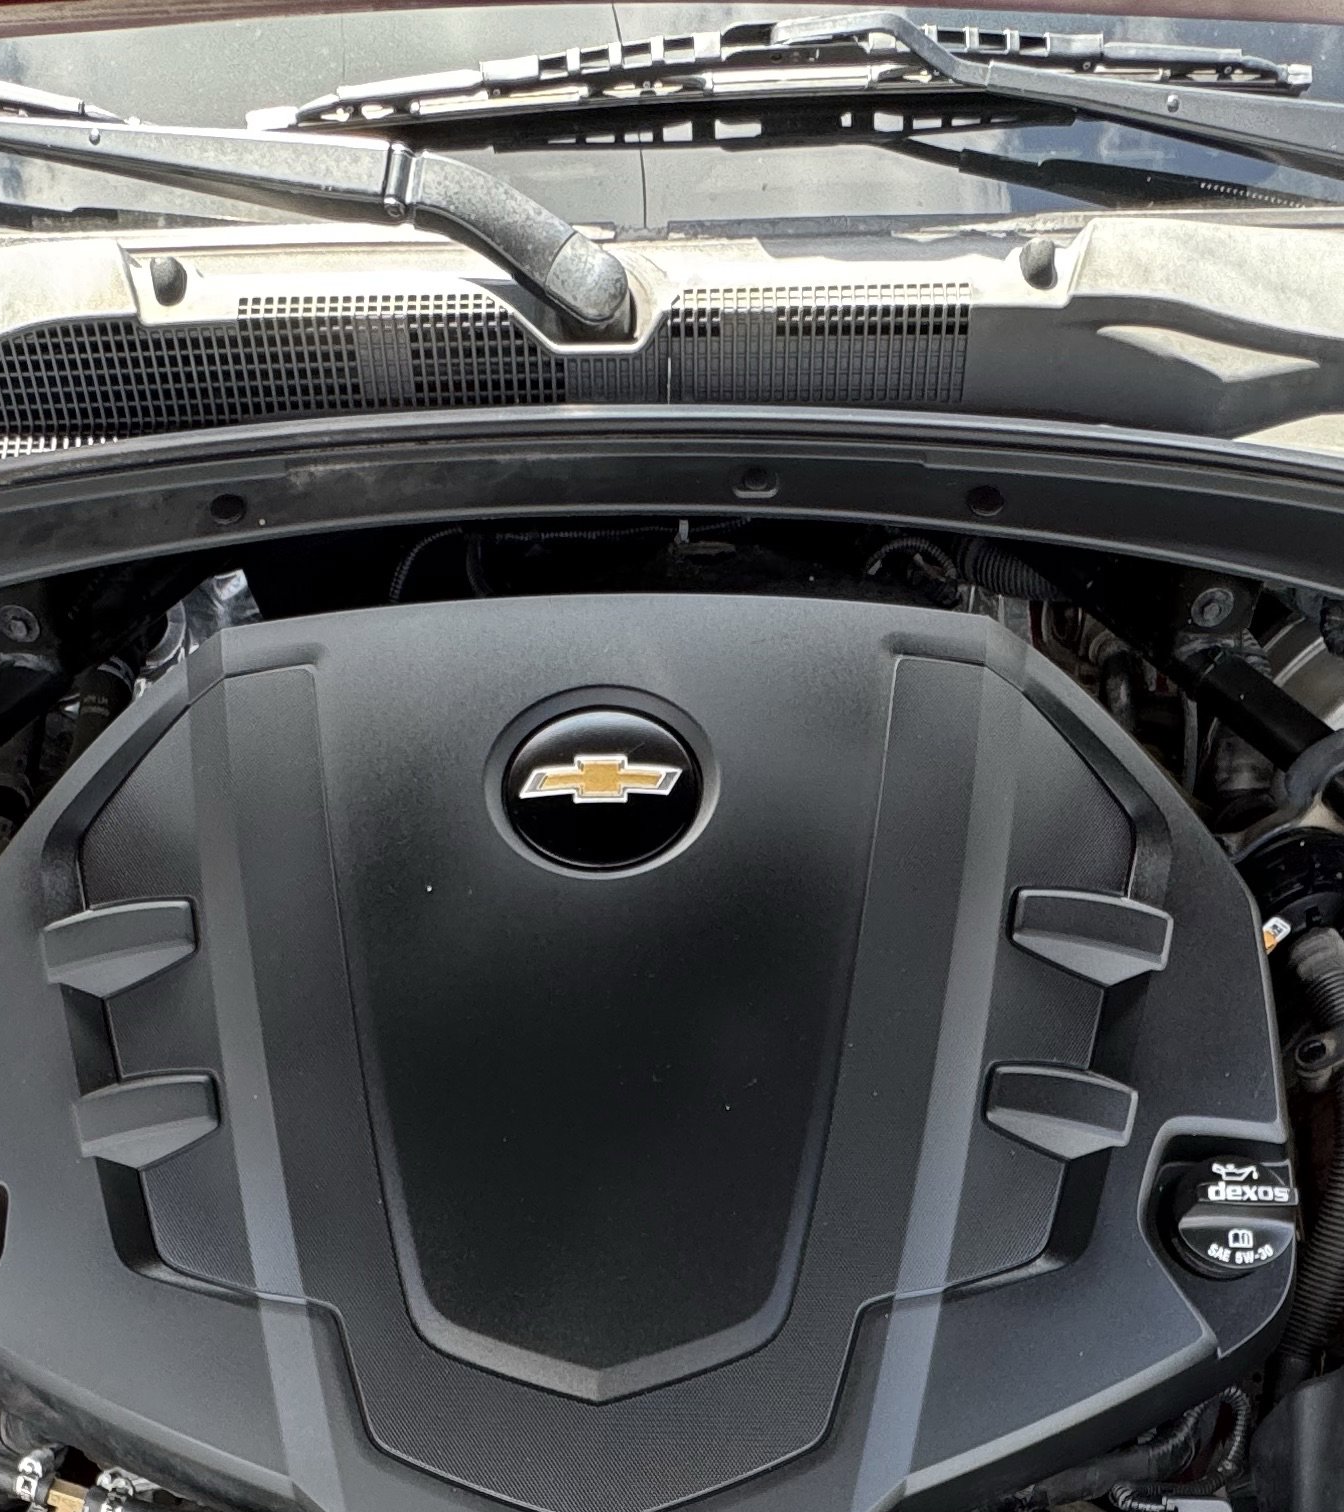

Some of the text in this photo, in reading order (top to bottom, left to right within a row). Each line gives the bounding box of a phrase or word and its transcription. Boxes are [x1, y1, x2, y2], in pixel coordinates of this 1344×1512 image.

[1207, 1182, 1289, 1202] dexos
[1207, 1243, 1274, 1264] SAE 5W-30
